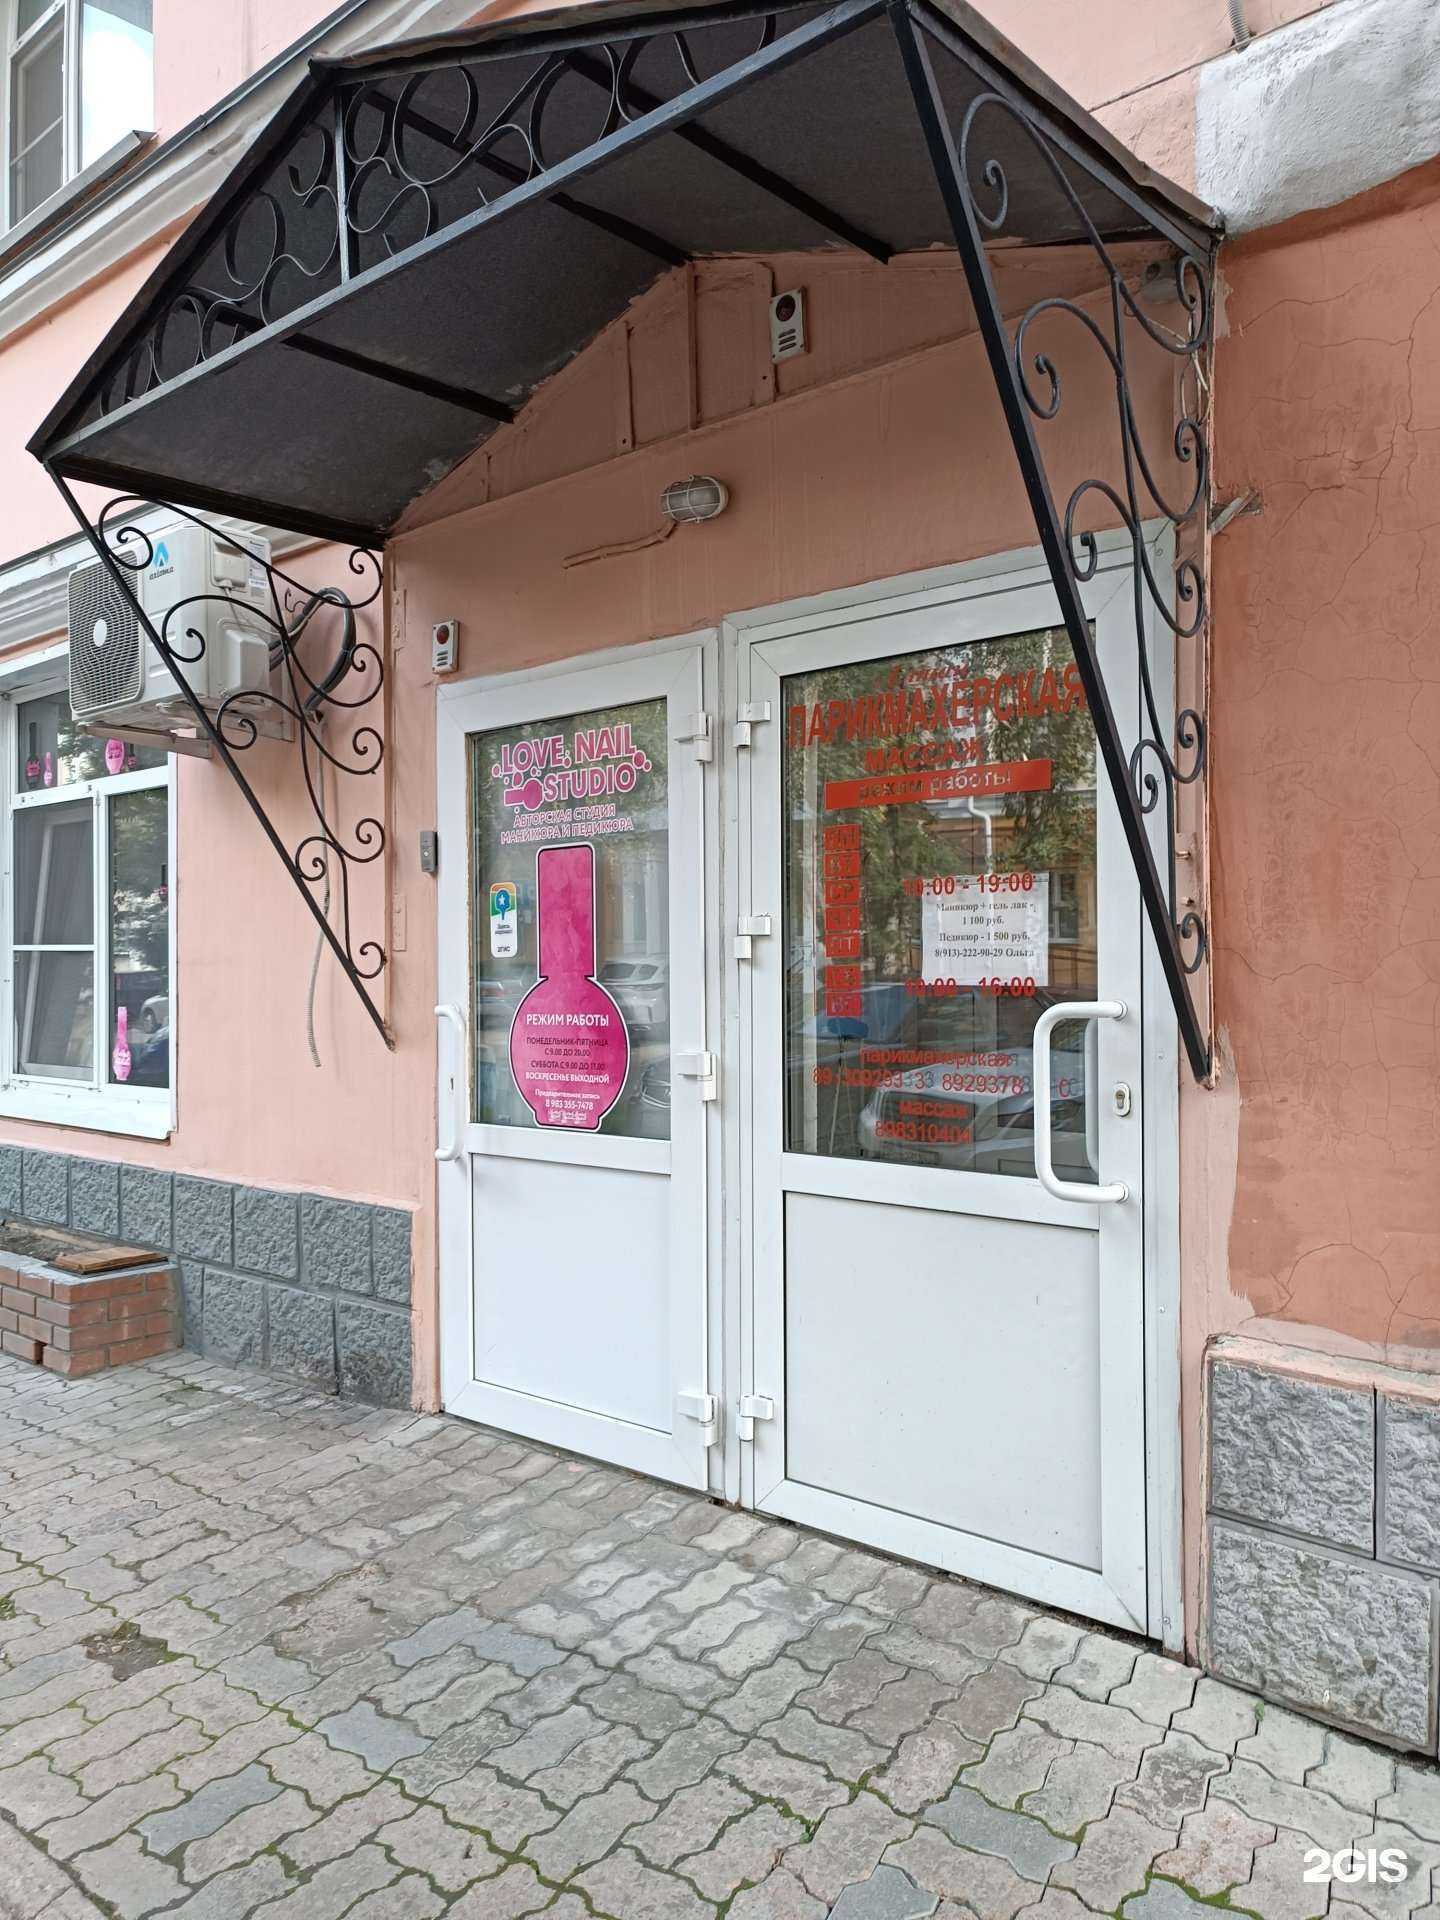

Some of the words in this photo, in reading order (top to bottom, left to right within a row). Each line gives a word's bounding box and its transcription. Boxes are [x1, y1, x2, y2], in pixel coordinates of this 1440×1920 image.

[788, 663, 1086, 747] ПАРИКМАХЕРСКАЯ
[501, 735, 564, 775] LOVE
[574, 723, 637, 764] NAIL
[864, 737, 985, 772] МАССАЖ
[543, 762, 636, 802] STUDIO
[930, 770, 1012, 796] работы
[513, 809, 572, 828] АВТОРСКАЯ
[573, 803, 616, 821] СТУДИЯ
[501, 826, 562, 845] МАНИКЮРА
[562, 824, 571, 837] И
[571, 818, 634, 836] ПЕДИКЮРА
[977, 872, 1034, 893] 19:00
[970, 915, 984, 925] 100
[986, 916, 1005, 927] руб.
[939, 932, 979, 943] Педикюр
[993, 931, 1009, 941] 500
[978, 976, 1036, 997] 16:00
[526, 1014, 564, 1025] РЕЖИМ
[566, 1014, 609, 1026] РАБОТЫ
[570, 1073, 609, 1084] ВЫХОДНОЙ
